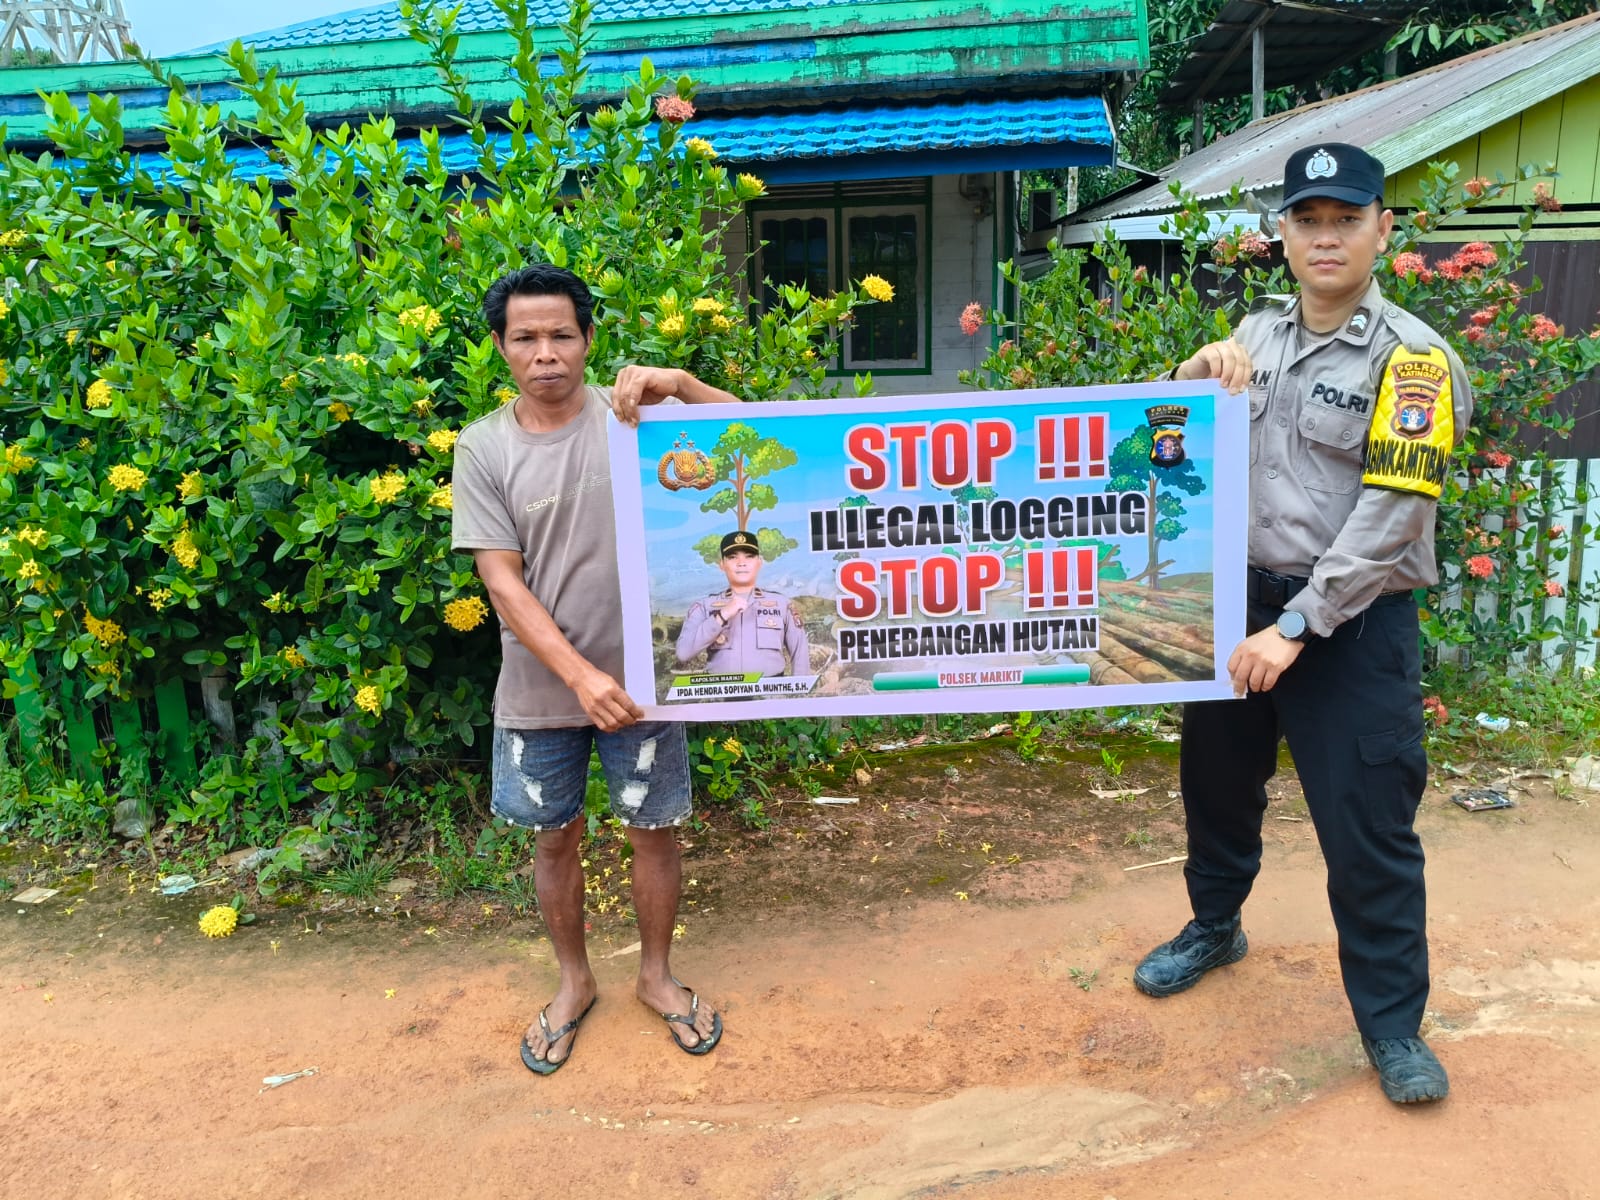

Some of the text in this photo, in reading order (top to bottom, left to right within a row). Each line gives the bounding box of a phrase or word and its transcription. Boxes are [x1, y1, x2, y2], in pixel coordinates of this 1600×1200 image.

[1396, 362, 1443, 377] POLRES
[1311, 382, 1369, 414] POLRI
[847, 415, 1105, 491] STOP !!!
[810, 492, 1146, 552] ILLEGAL LOGGING
[839, 549, 1094, 618] STOP !!!
[757, 609, 782, 617] POLRI
[840, 617, 1097, 660] PENEBANGAN HUTAN
[676, 682, 809, 697] IPDA HENDRA SOPIYAN D. MUNTHE, S.H.
[939, 669, 1022, 685] POLSEK MARIKIT
